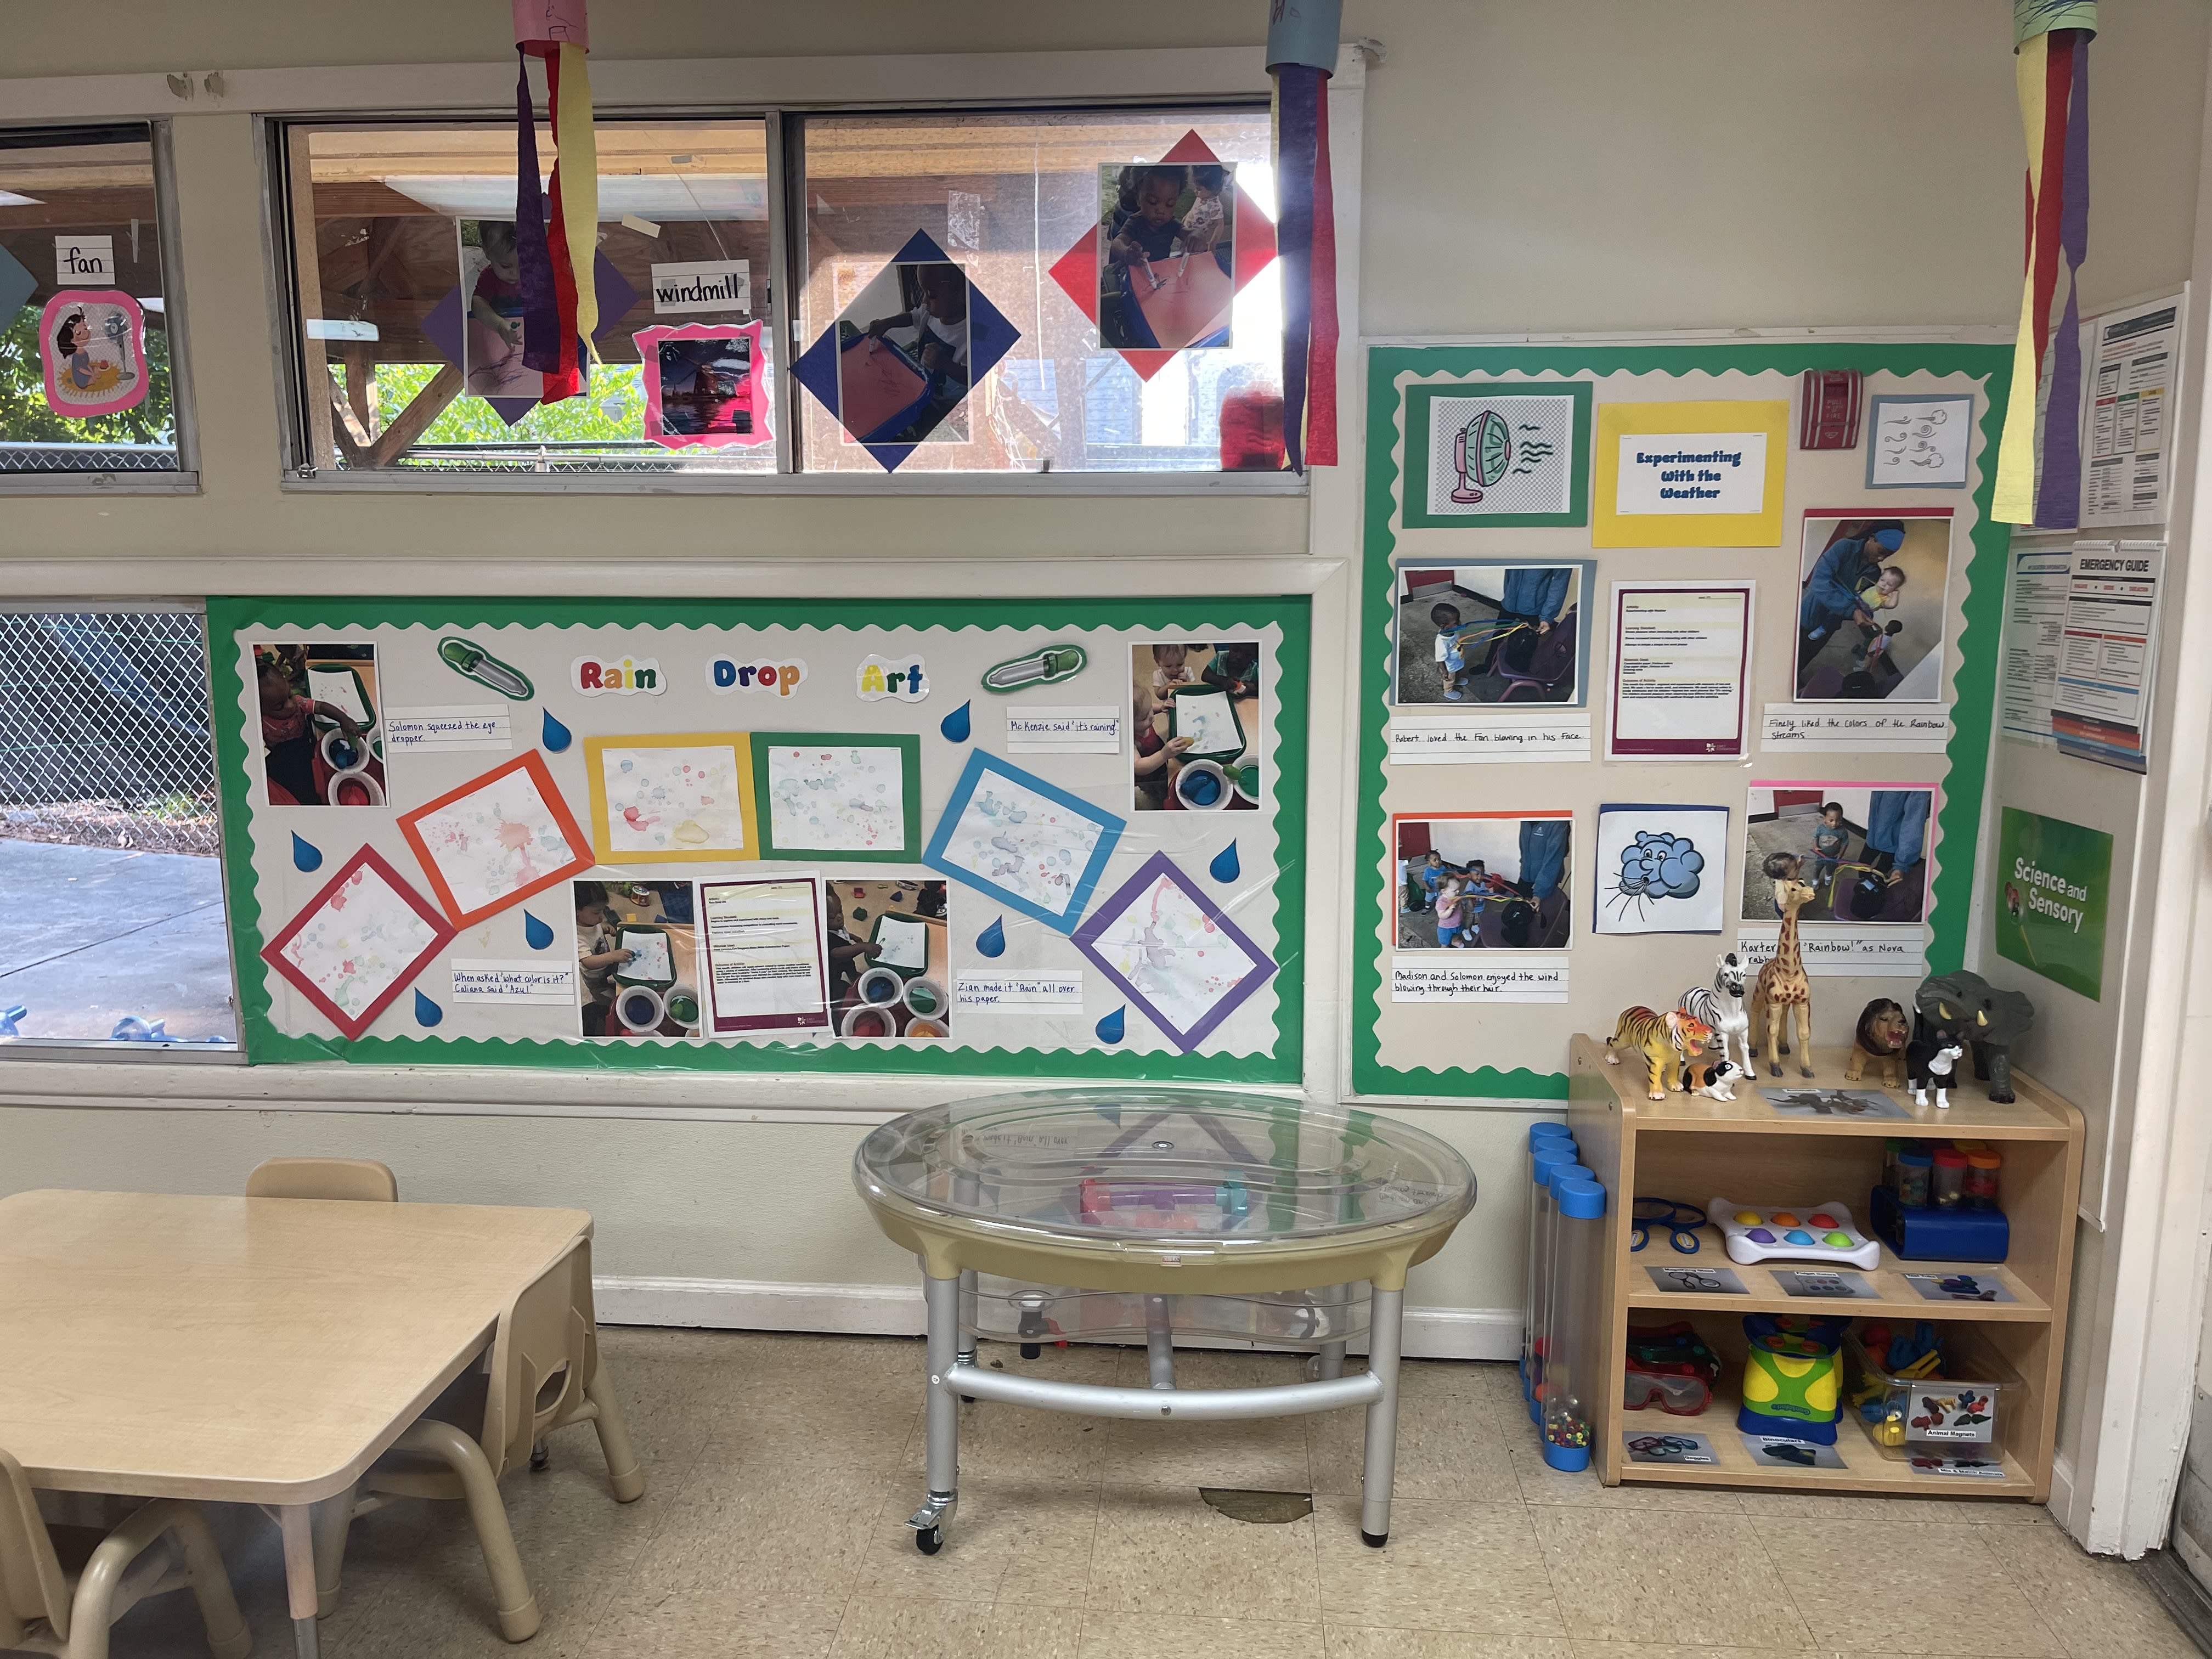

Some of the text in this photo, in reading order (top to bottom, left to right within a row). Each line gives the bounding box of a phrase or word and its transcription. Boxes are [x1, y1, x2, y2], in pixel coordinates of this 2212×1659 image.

[63, 246, 103, 274] fan
[656, 273, 738, 302] windmill
[1637, 450, 1741, 467] Experimenting
[1661, 470, 1722, 482] With the
[1660, 487, 1720, 499] Weather
[2080, 558, 2125, 571] EMERGENCY
[2125, 560, 2149, 572] GUIDE
[580, 659, 923, 696] Rain Drop Art
[388, 720, 496, 734] Solomon squeezed the eye
[1053, 721, 1070, 730] said
[1827, 718, 1839, 727] the
[1875, 718, 1887, 727] of
[1892, 718, 1905, 728] the
[1910, 719, 1945, 728] Rainbow
[392, 734, 426, 746] dropper.
[1395, 733, 1419, 743] Robert
[1427, 732, 1447, 742] loved
[1454, 732, 1468, 741] the
[1494, 733, 1523, 743] blowing
[1543, 732, 1556, 741] his
[2015, 857, 2087, 901] Science and
[2028, 887, 2084, 934] Sensory
[1741, 941, 1776, 952] Karter
[1879, 945, 1904, 953] Nova
[454, 972, 475, 982] When
[524, 974, 541, 984] color
[543, 975, 550, 984] is
[1395, 970, 1559, 985] Madison and Solomon enjoyed the wind
[487, 984, 503, 992] said
[984, 982, 1002, 992] made
[1004, 982, 1013, 992] it
[1042, 984, 1055, 992] all
[1395, 983, 1503, 996] blowing through their hair.
[960, 995, 1000, 1006] his paper.
